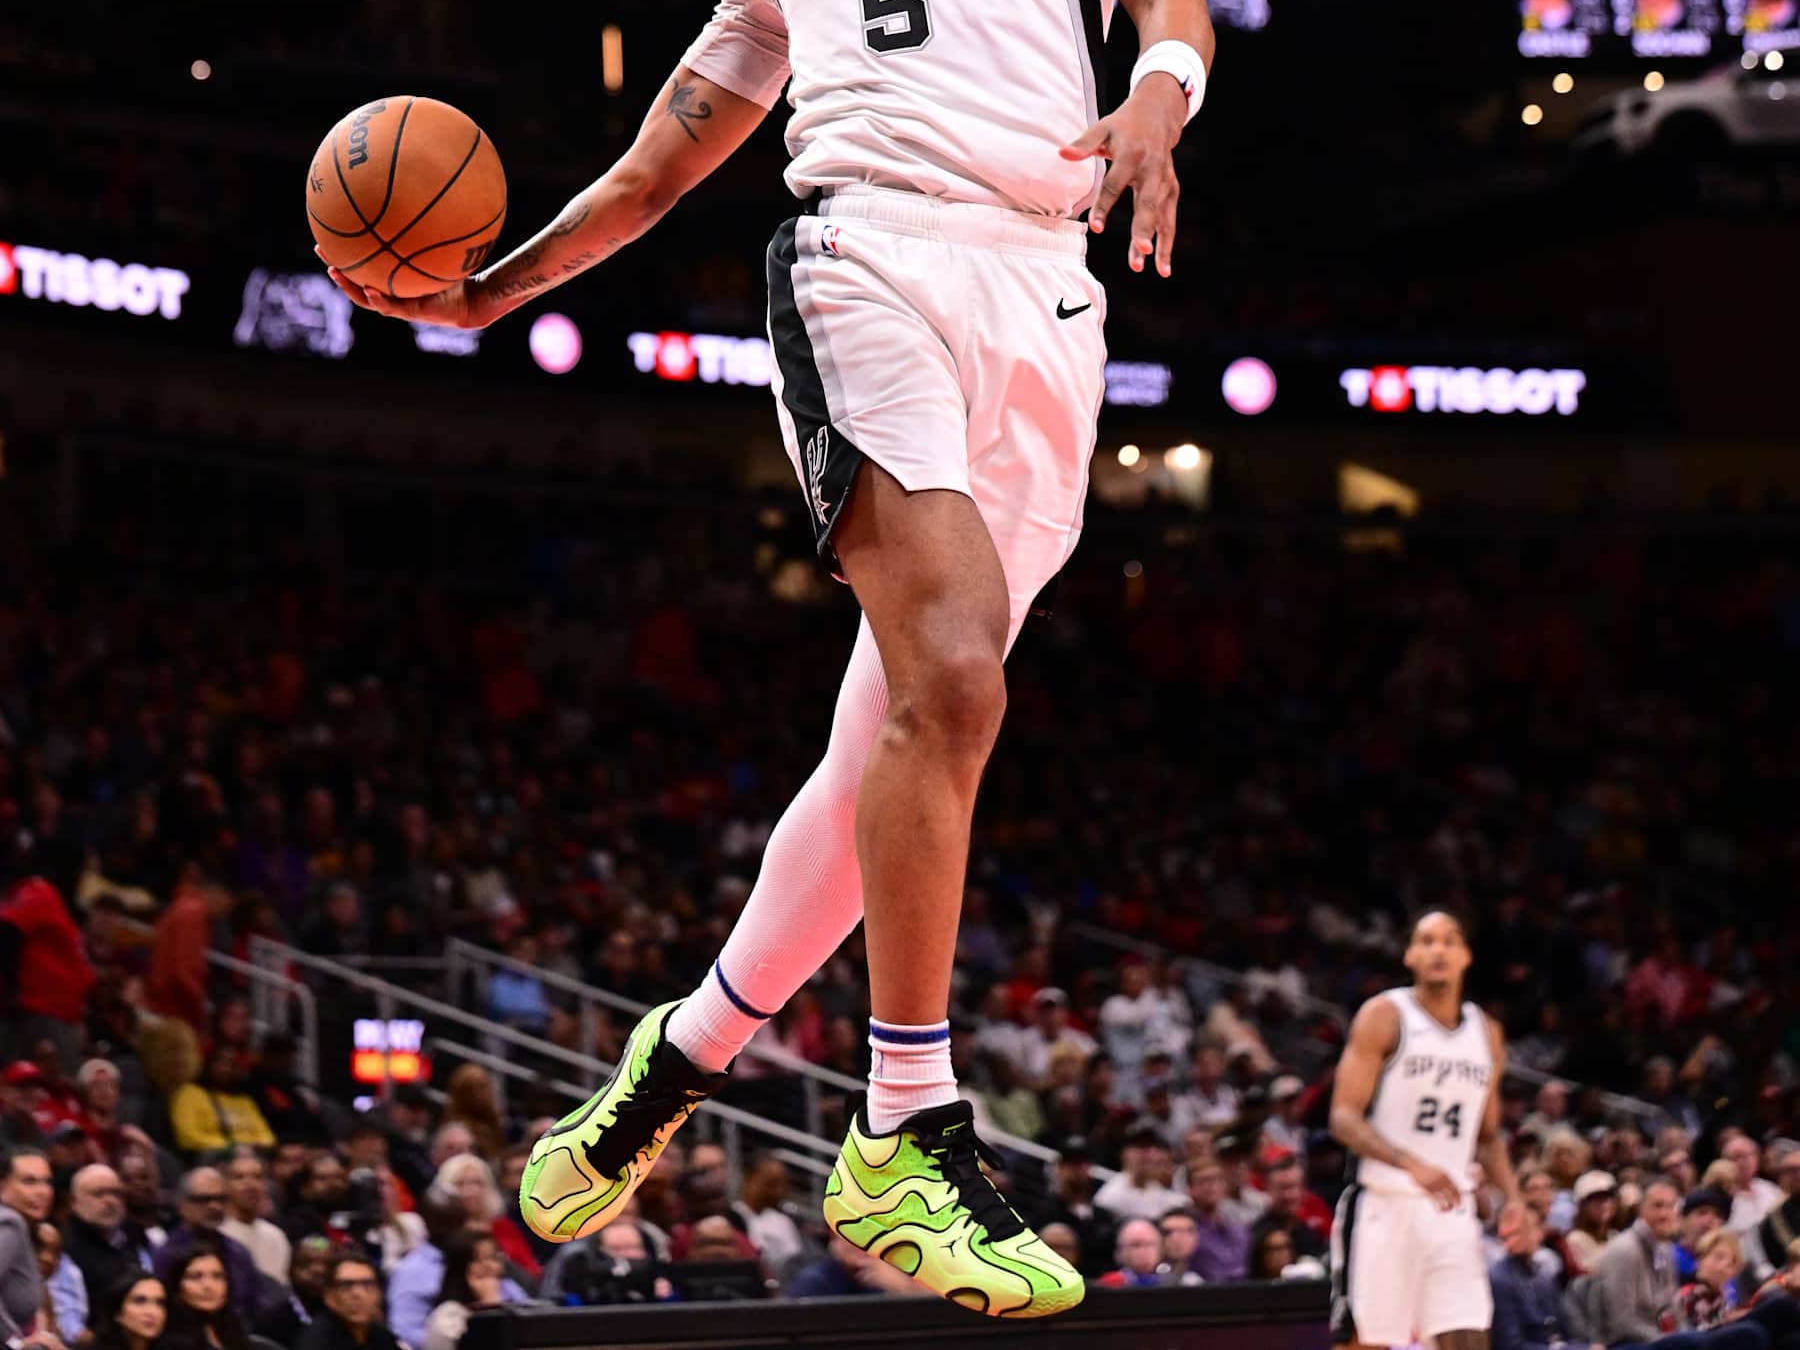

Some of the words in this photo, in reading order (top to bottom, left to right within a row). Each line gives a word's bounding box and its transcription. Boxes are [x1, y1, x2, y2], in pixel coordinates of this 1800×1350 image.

[14, 245, 190, 320] TISSOT
[694, 334, 771, 387] TIS
[1409, 366, 1586, 416] TISSOT
[1402, 1053, 1491, 1088] SPURS
[1415, 1096, 1462, 1139] 24
